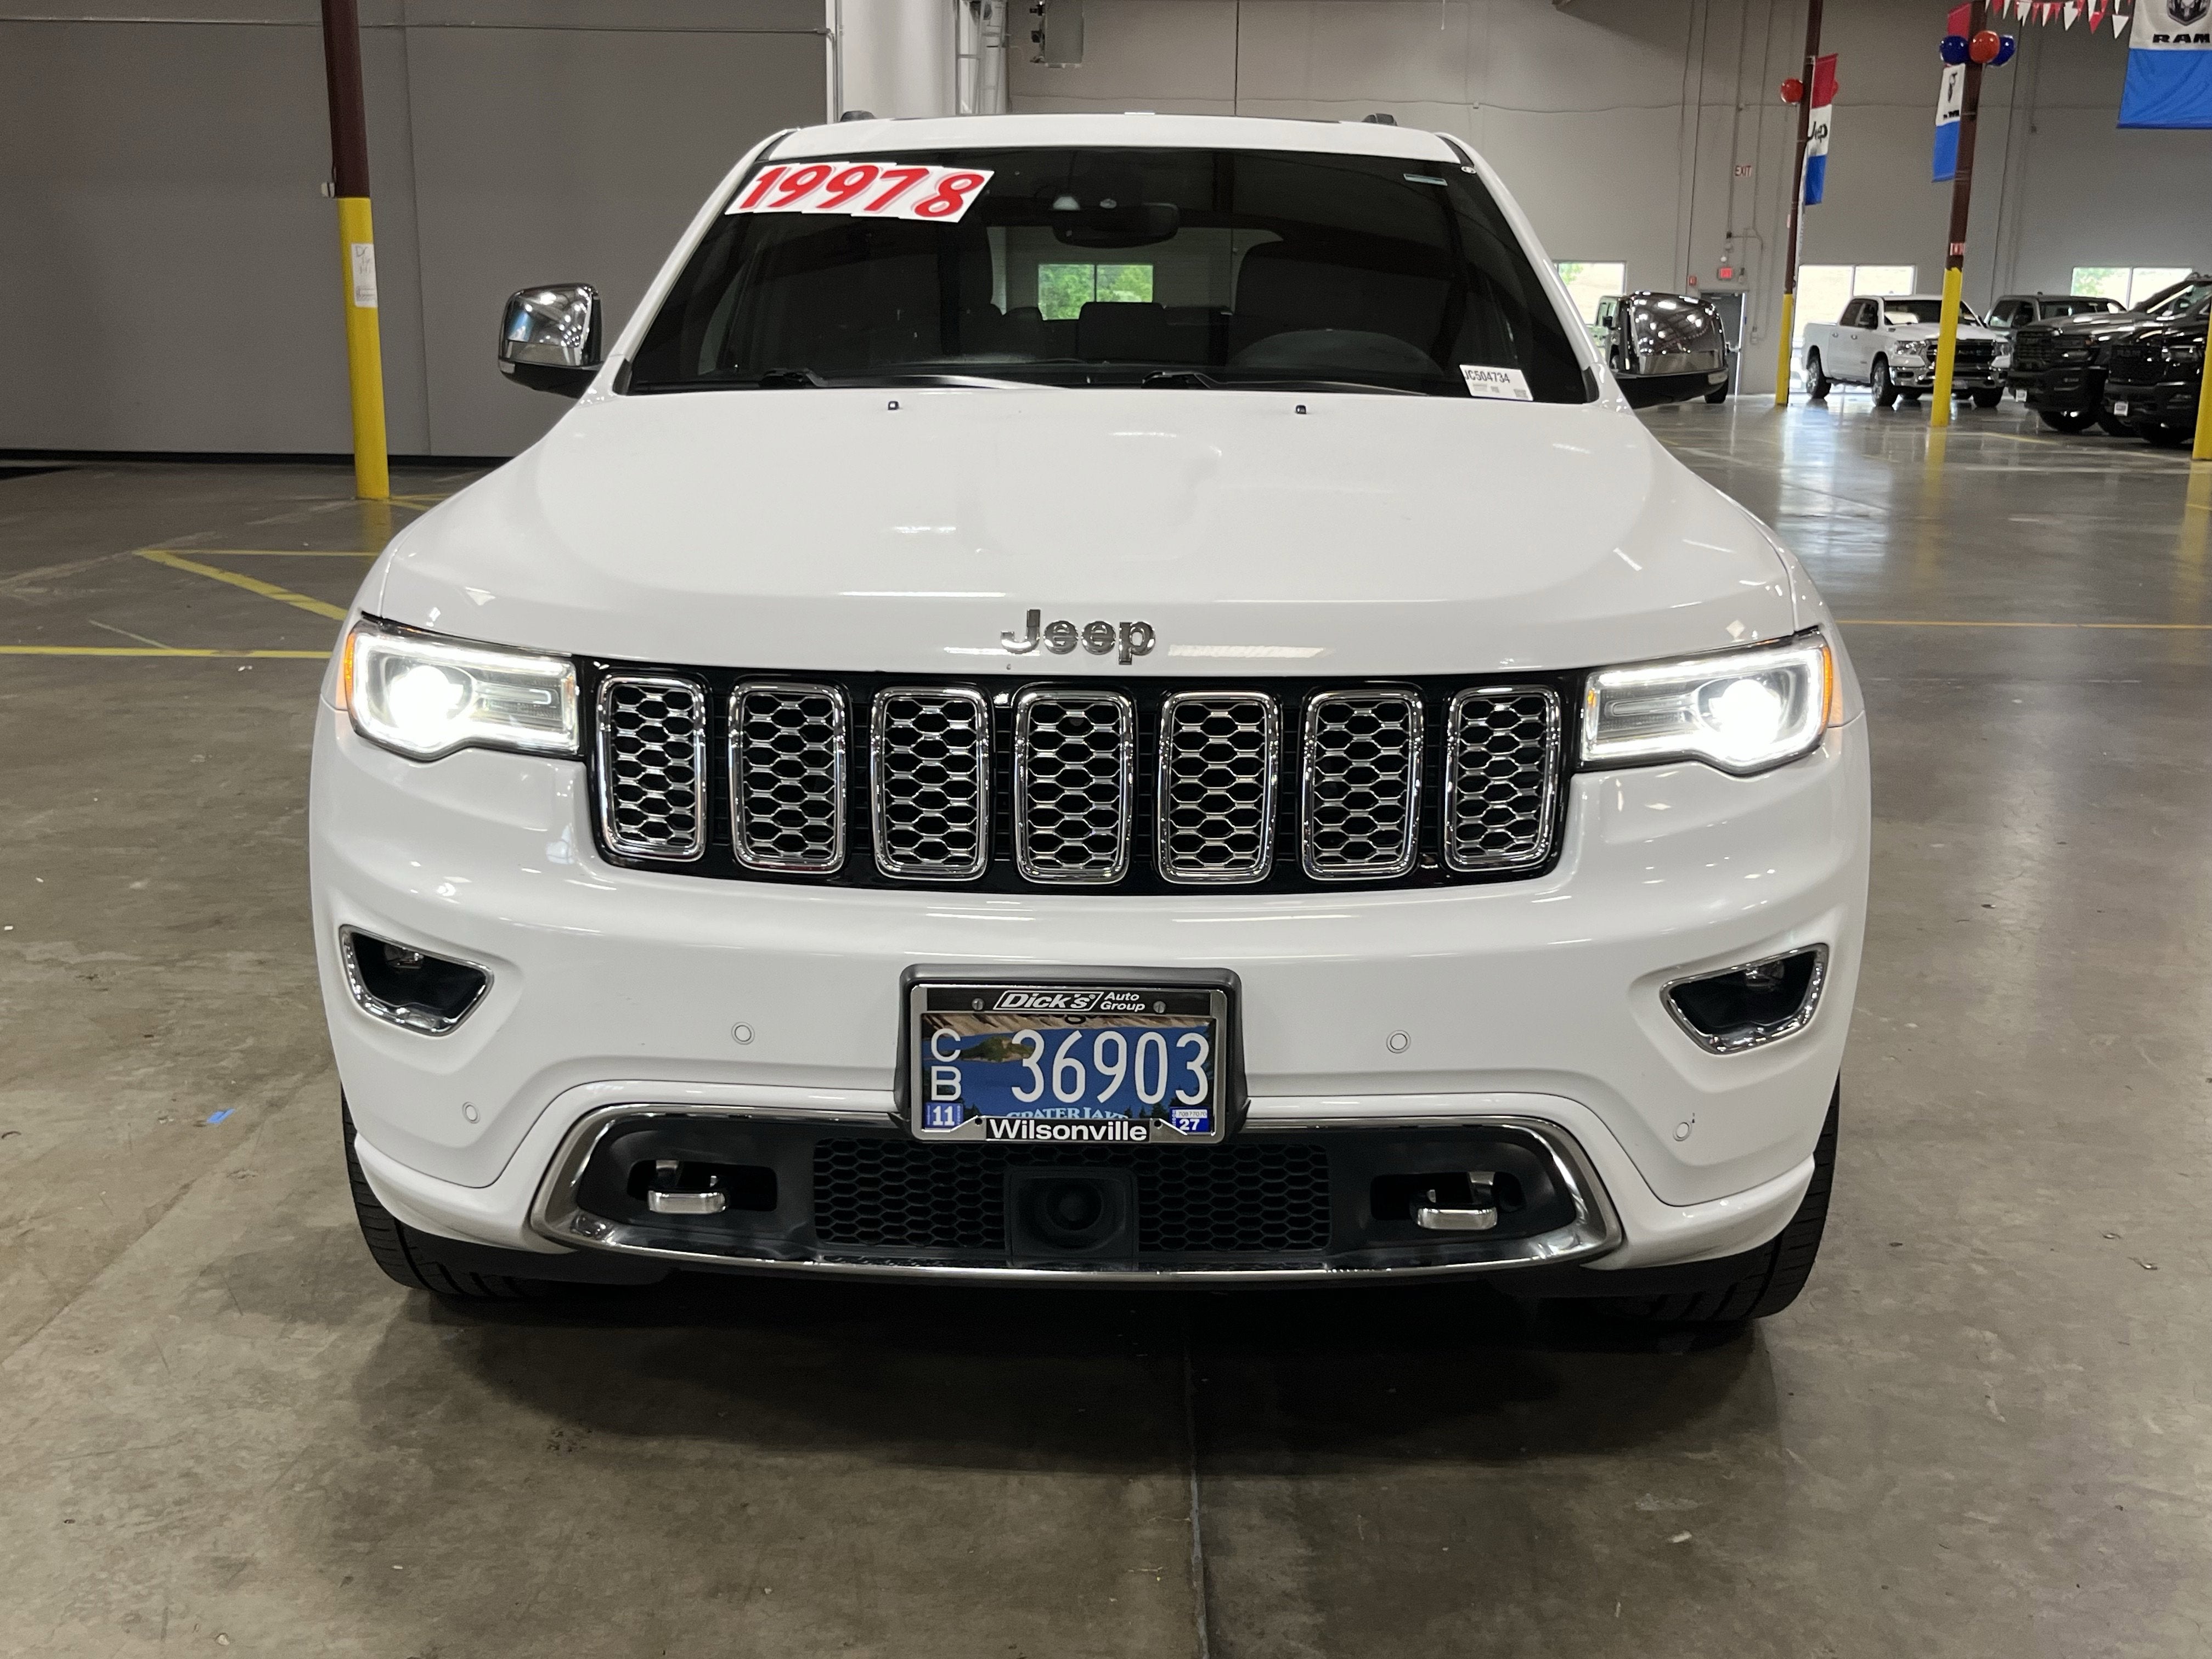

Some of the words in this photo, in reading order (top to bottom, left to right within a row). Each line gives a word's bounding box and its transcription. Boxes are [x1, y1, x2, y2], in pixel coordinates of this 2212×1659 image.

[2153, 33, 2210, 43] RAM
[1735, 166, 1751, 176] EXIT
[740, 165, 984, 217] 19978
[1000, 609, 1155, 665] Jeep
[1104, 992, 1139, 1001] Auto
[1100, 1001, 1146, 1012] Group
[1012, 1029, 1209, 1105] 36903
[933, 1105, 955, 1126] 11
[989, 1119, 1147, 1141] Wilsonville
[1180, 1118, 1200, 1130] 27
